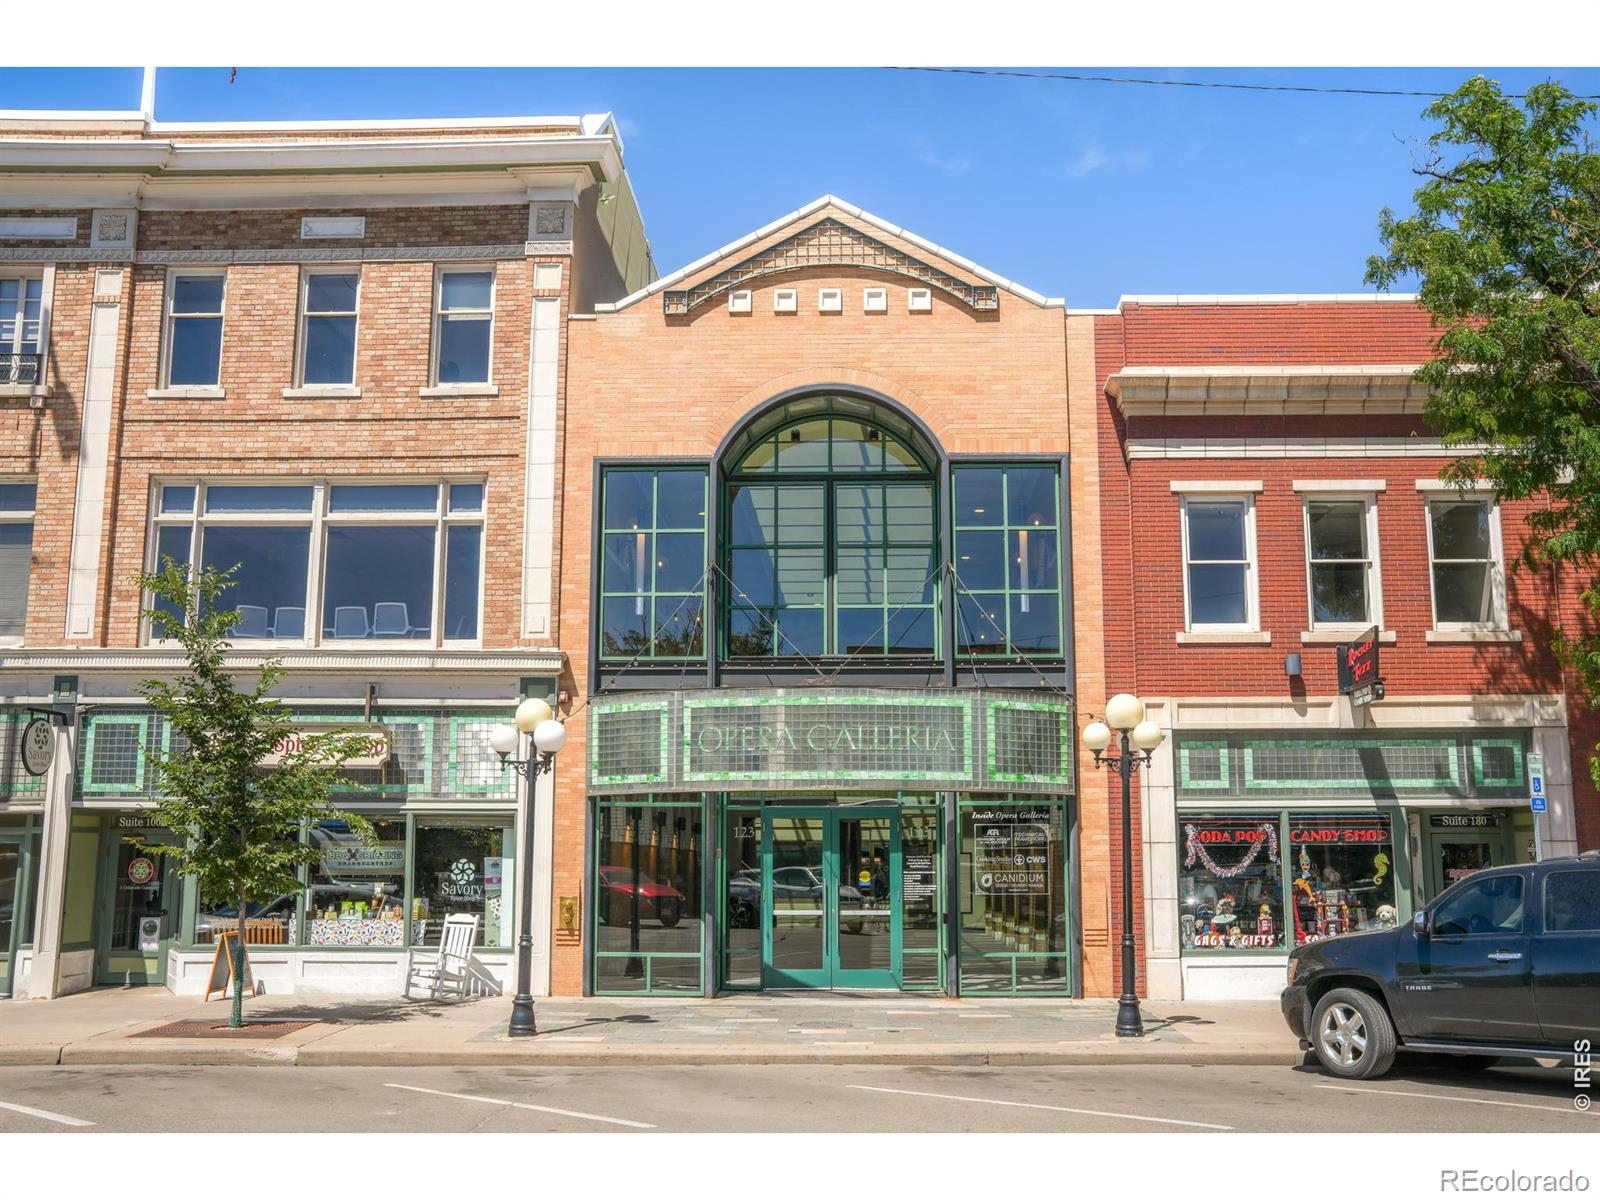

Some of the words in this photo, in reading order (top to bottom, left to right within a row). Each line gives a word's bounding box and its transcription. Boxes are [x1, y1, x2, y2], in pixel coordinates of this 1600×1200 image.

[698, 726, 796, 752] OPERA
[807, 724, 957, 751] GALLERIA
[972, 811, 994, 819] Inside
[995, 811, 1018, 821] Opera
[1020, 811, 1050, 819] Galleria
[1442, 816, 1468, 826] Suite
[1471, 816, 1487, 826] 180
[119, 817, 144, 827] Suite
[733, 827, 755, 838] 123
[1290, 830, 1340, 842] CANDY
[1026, 856, 1047, 864] CWS
[994, 873, 1044, 883] CANIDIUM
[441, 882, 483, 899] Savory
[1194, 935, 1225, 946] GAGS
[1242, 935, 1274, 946] GIFTS
